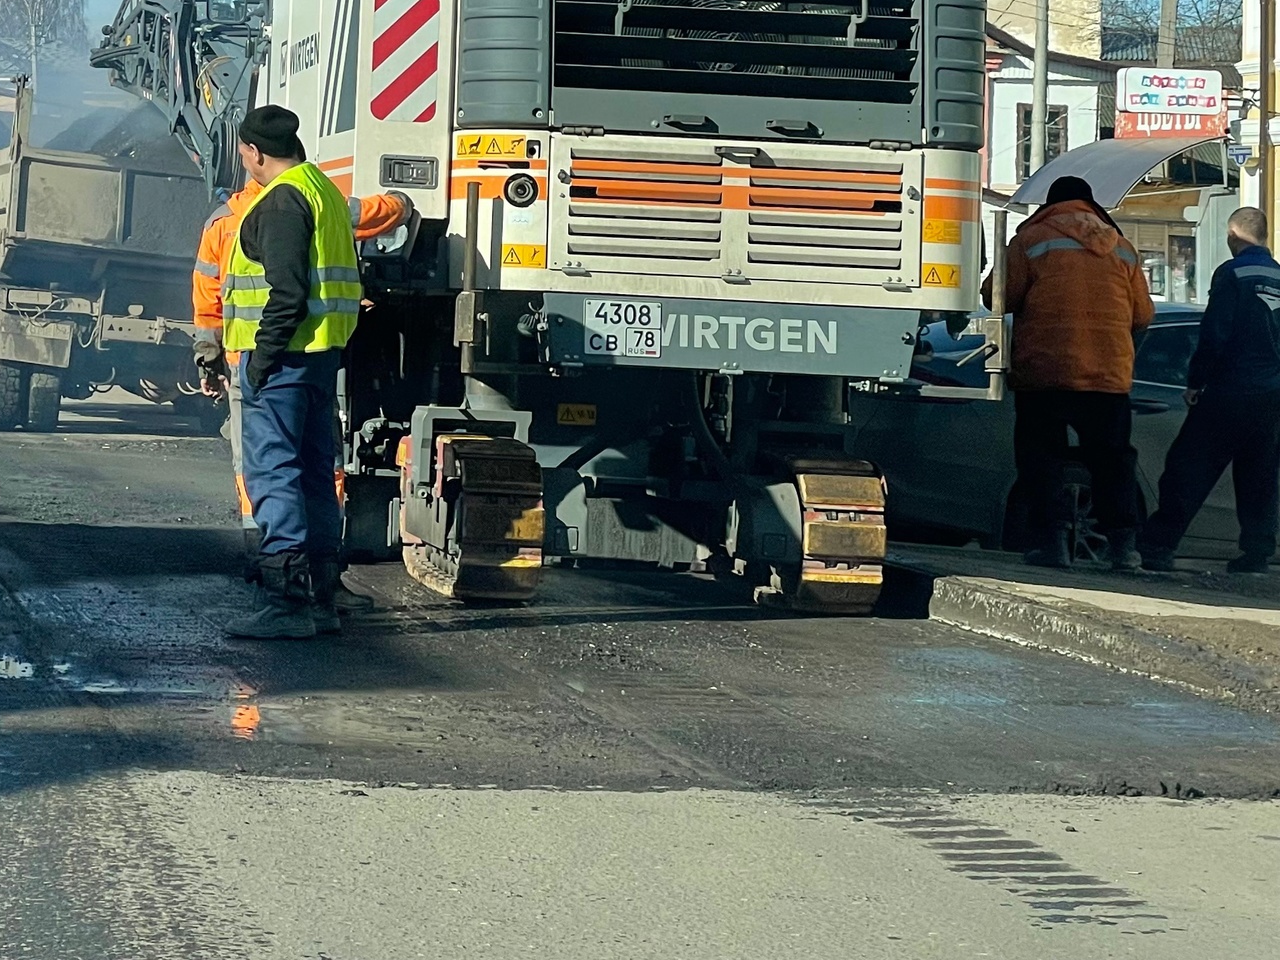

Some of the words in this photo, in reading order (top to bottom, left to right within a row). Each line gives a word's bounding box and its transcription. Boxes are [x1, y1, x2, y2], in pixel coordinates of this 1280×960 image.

[289, 31, 321, 77] WIRTGEN
[1141, 75, 1207, 90] ДЕТСКИЙ
[594, 302, 652, 326] 4308
[589, 333, 619, 352] СВ
[633, 330, 656, 348] 78
[627, 347, 645, 356] RUS
